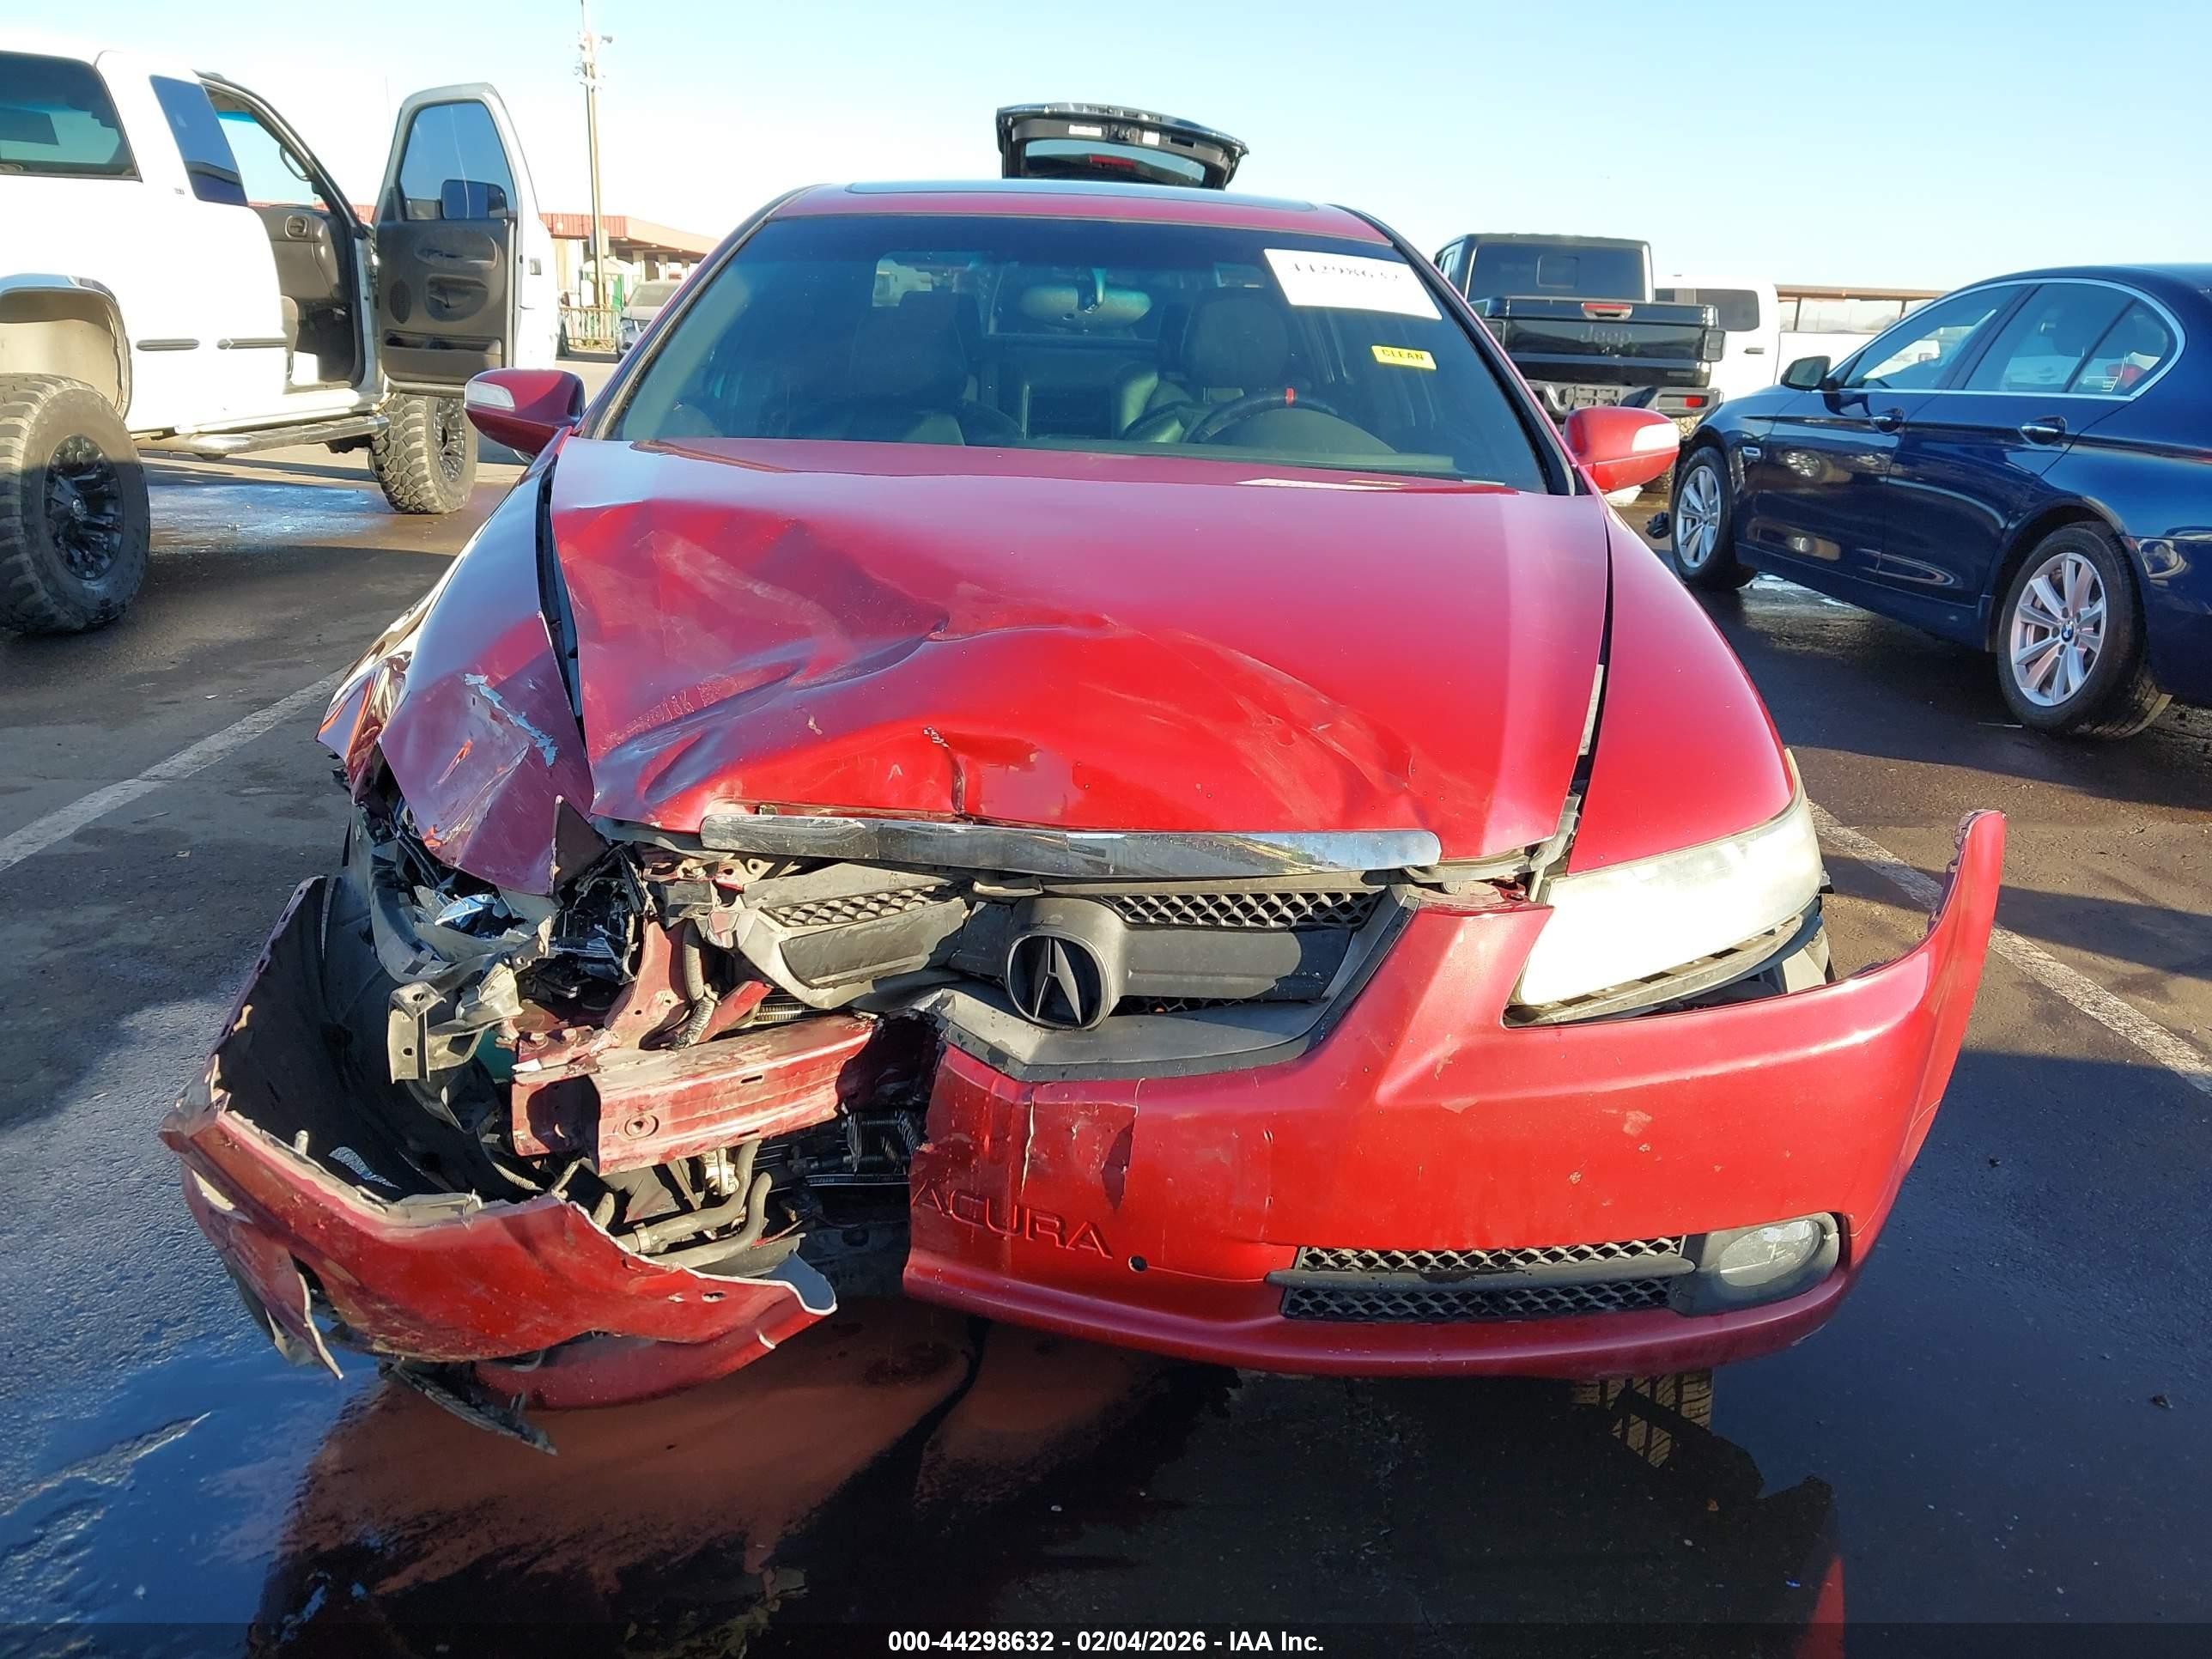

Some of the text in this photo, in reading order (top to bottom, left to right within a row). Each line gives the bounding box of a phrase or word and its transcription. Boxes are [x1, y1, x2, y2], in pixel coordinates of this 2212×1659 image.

[1579, 325, 1632, 347] Jeep
[1379, 349, 1425, 360] CLEAN
[911, 1180, 1114, 1260] ACURA
